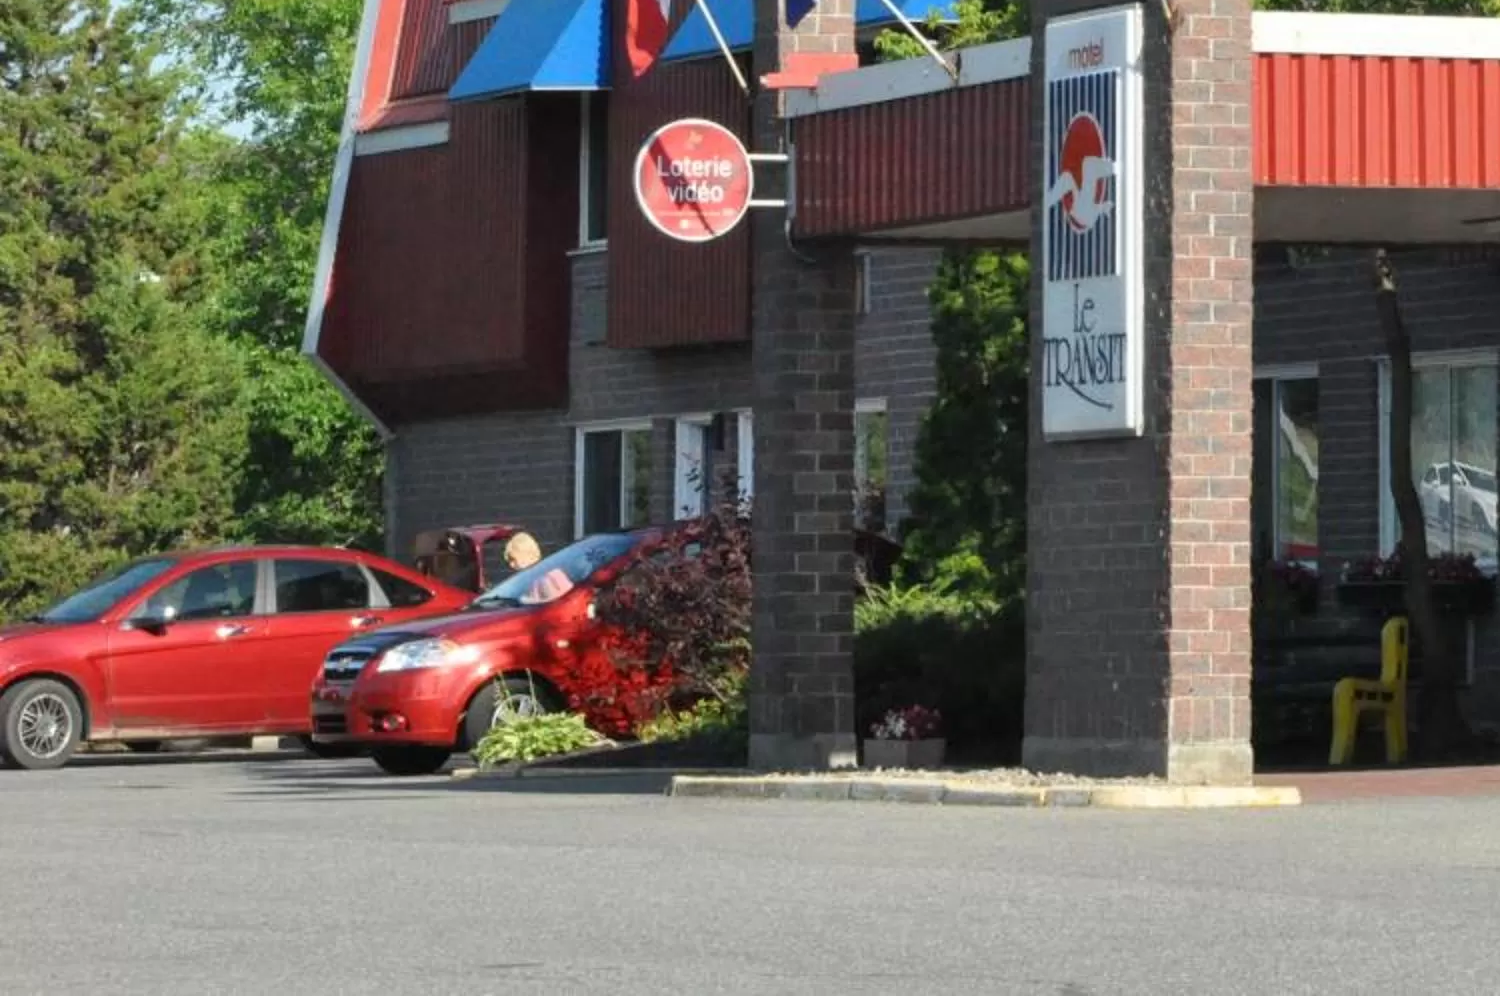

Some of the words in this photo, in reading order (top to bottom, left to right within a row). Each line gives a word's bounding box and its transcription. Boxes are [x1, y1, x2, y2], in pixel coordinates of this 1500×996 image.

[1069, 38, 1104, 66] motel
[657, 155, 732, 177] Loterie
[668, 180, 724, 203] vidéo
[1044, 332, 1126, 410] TRANSIT
